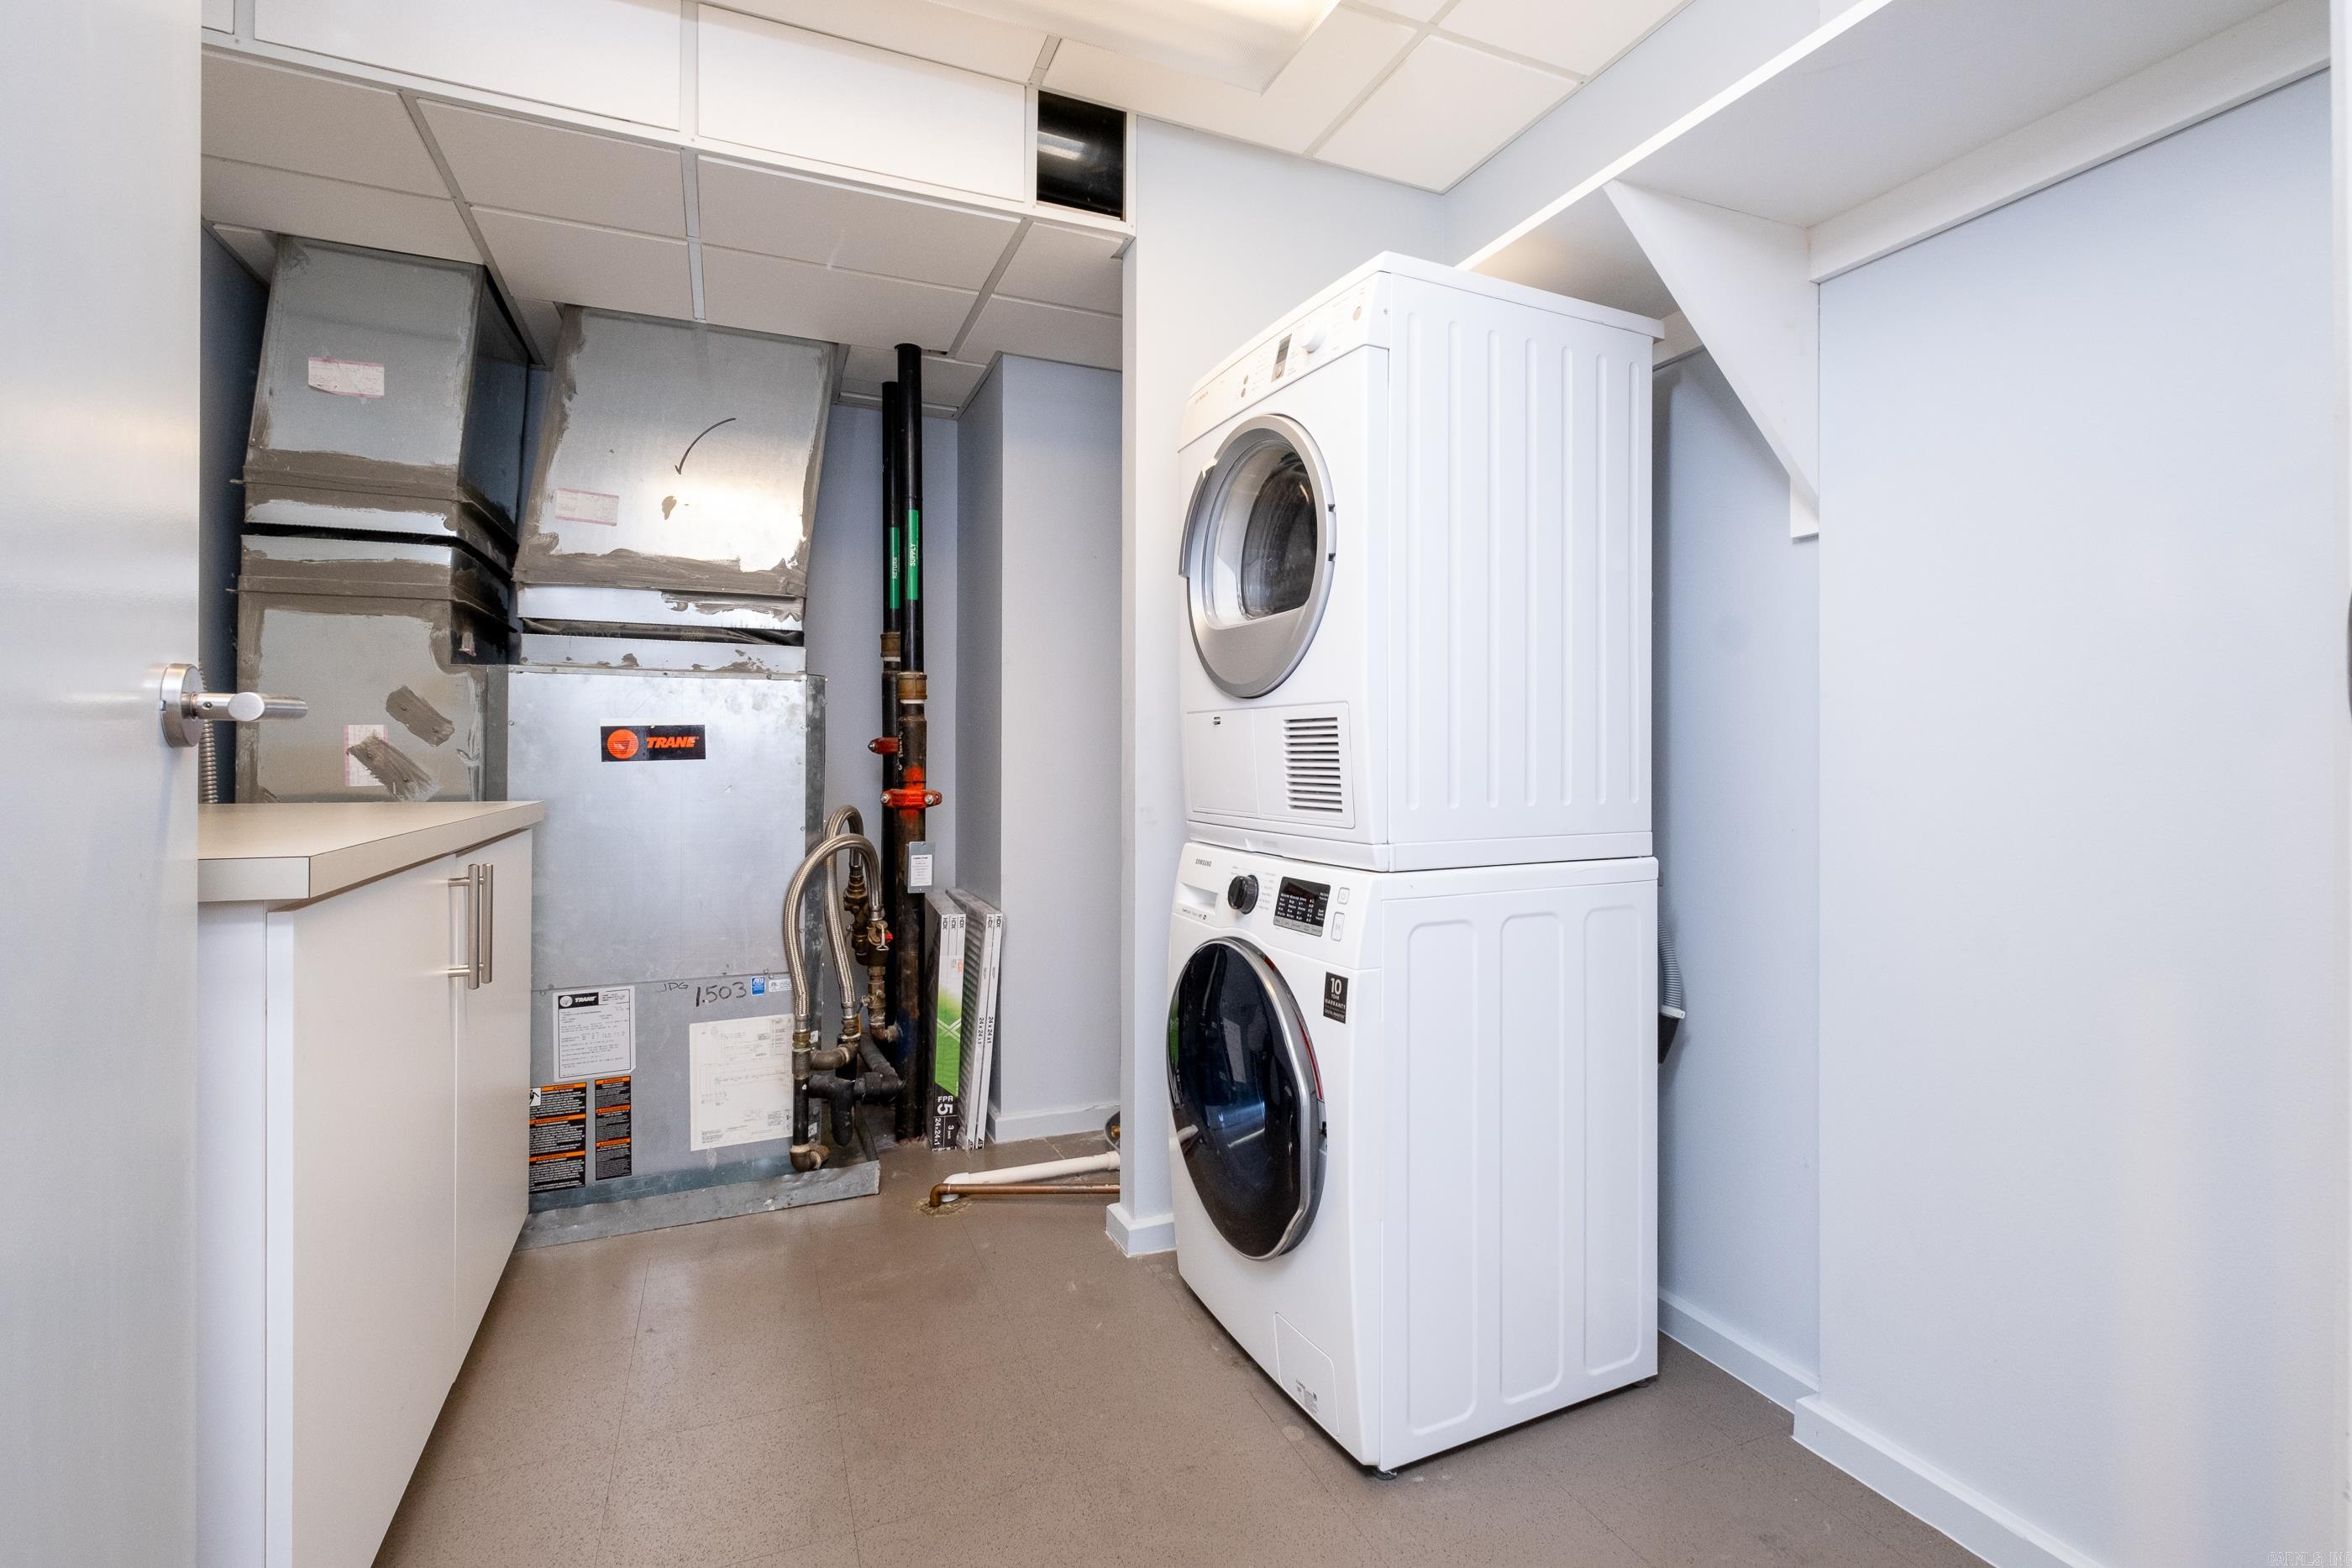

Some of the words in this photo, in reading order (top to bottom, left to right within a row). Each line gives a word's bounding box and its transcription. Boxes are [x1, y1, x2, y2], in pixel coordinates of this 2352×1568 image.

[646, 736, 696, 748] TRANE
[1195, 858, 1212, 868] SAMSUNG
[1331, 978, 1341, 995] 10
[1325, 999, 1346, 1009] WARRANTY
[937, 1104, 953, 1115] 5
